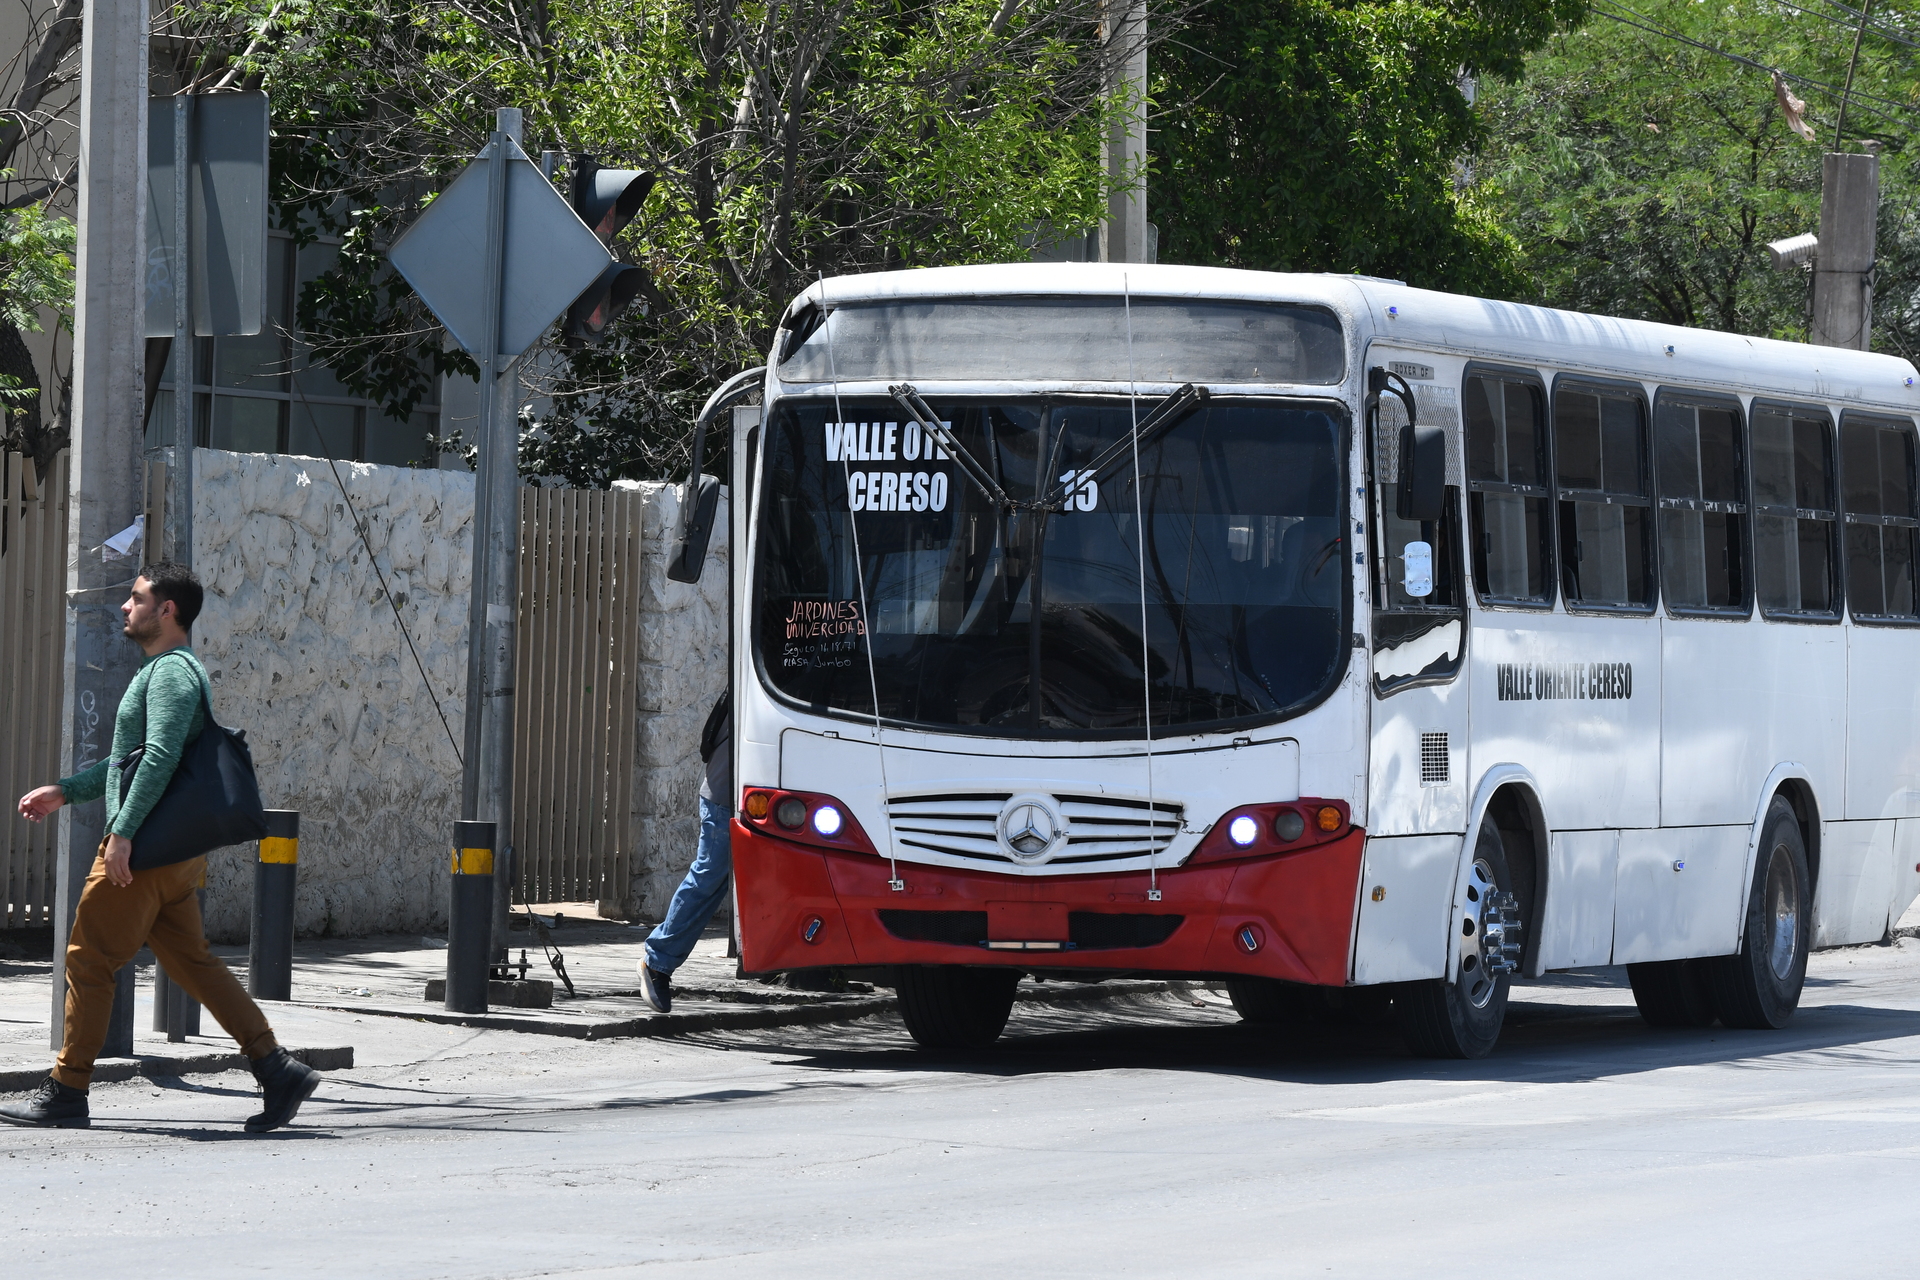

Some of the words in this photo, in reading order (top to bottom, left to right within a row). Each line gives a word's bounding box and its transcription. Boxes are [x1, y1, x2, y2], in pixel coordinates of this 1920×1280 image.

[1394, 363, 1417, 377] BOXER
[1420, 367, 1429, 378] OF
[824, 421, 898, 462] VALLE
[902, 420, 957, 461] OTE
[848, 471, 949, 512] CERESO
[1059, 469, 1098, 512] 15
[785, 601, 859, 622] JARDINES
[1497, 662, 1532, 701] VALLE
[1535, 662, 1585, 700] ORIENTE
[1588, 662, 1632, 700] CERESO
